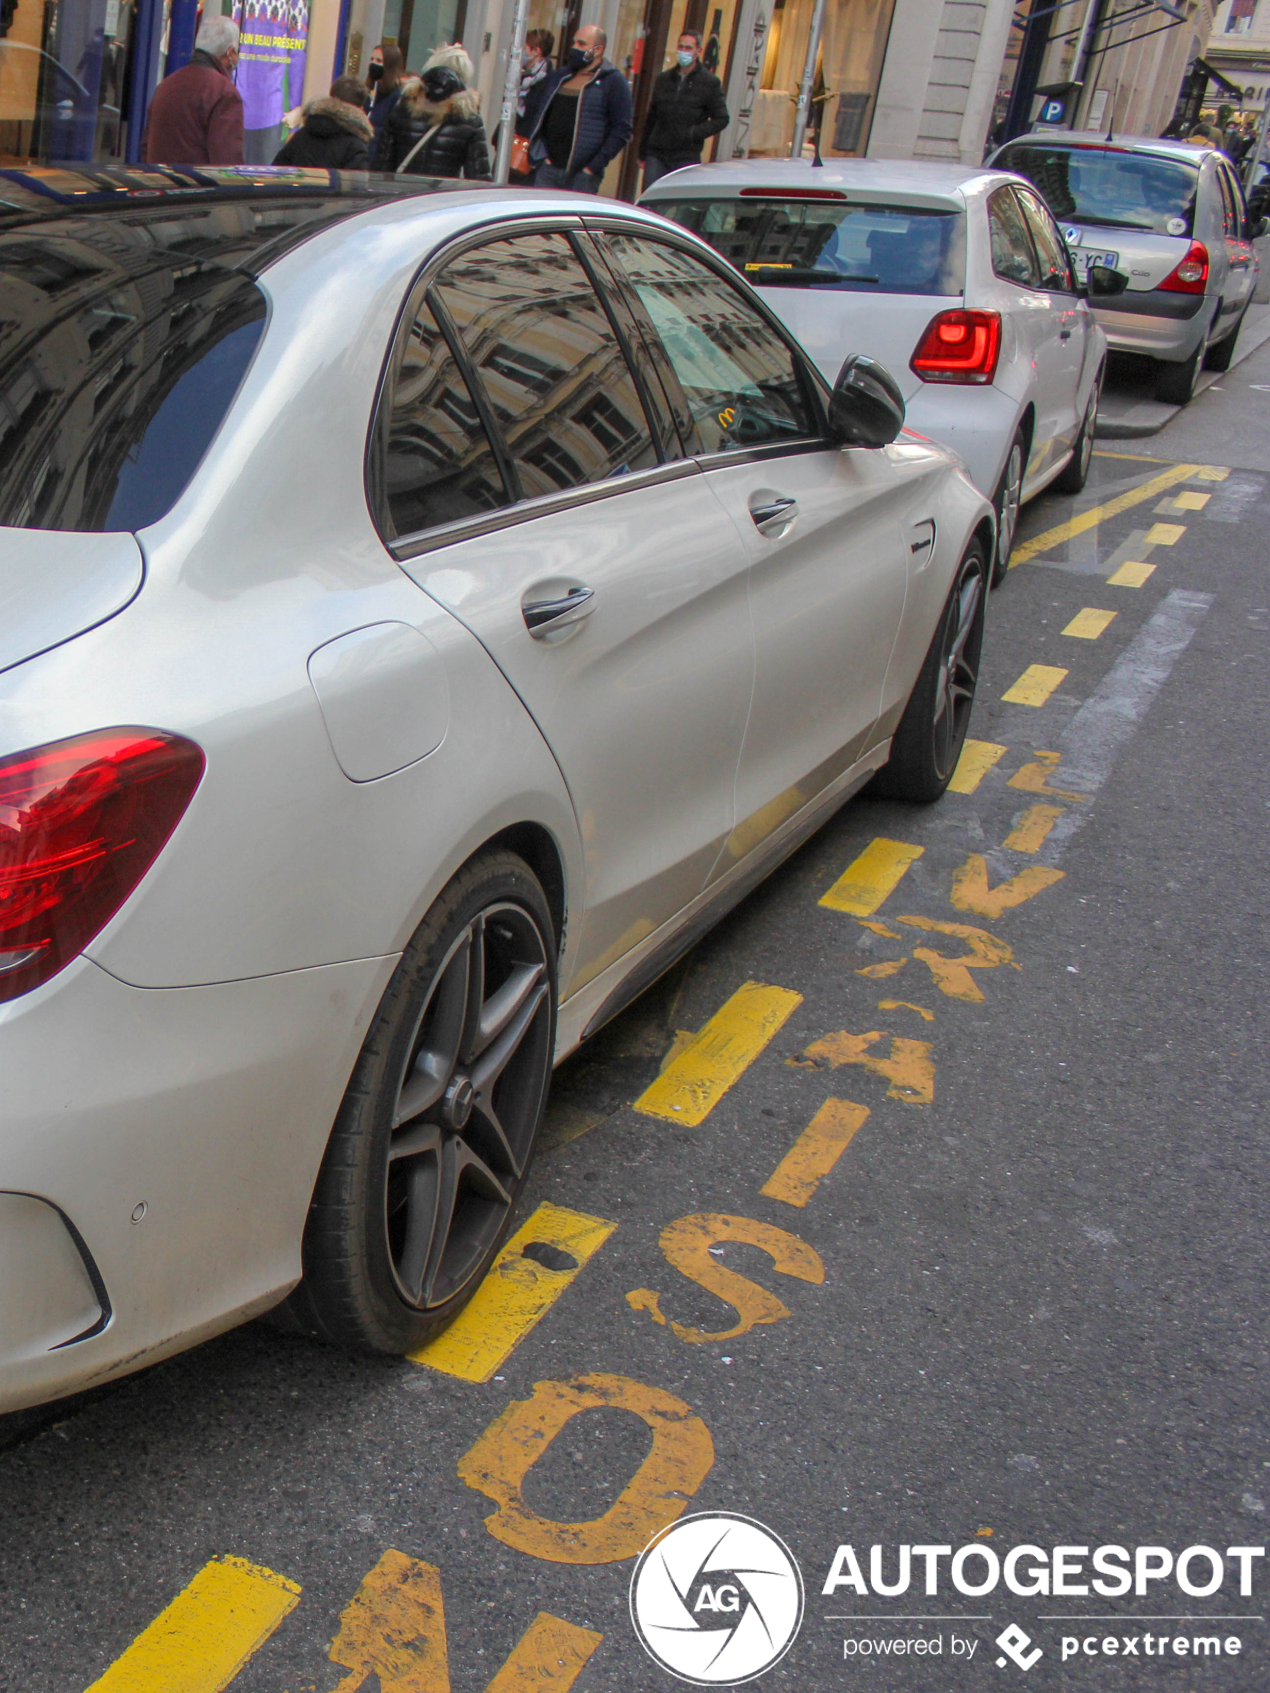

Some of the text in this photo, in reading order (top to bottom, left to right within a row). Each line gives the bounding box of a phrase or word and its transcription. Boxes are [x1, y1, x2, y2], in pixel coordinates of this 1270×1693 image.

[243, 33, 254, 44] UN
[254, 34, 272, 47] BEAU
[272, 34, 306, 50] PRÉSENT
[1046, 102, 1060, 120] P
